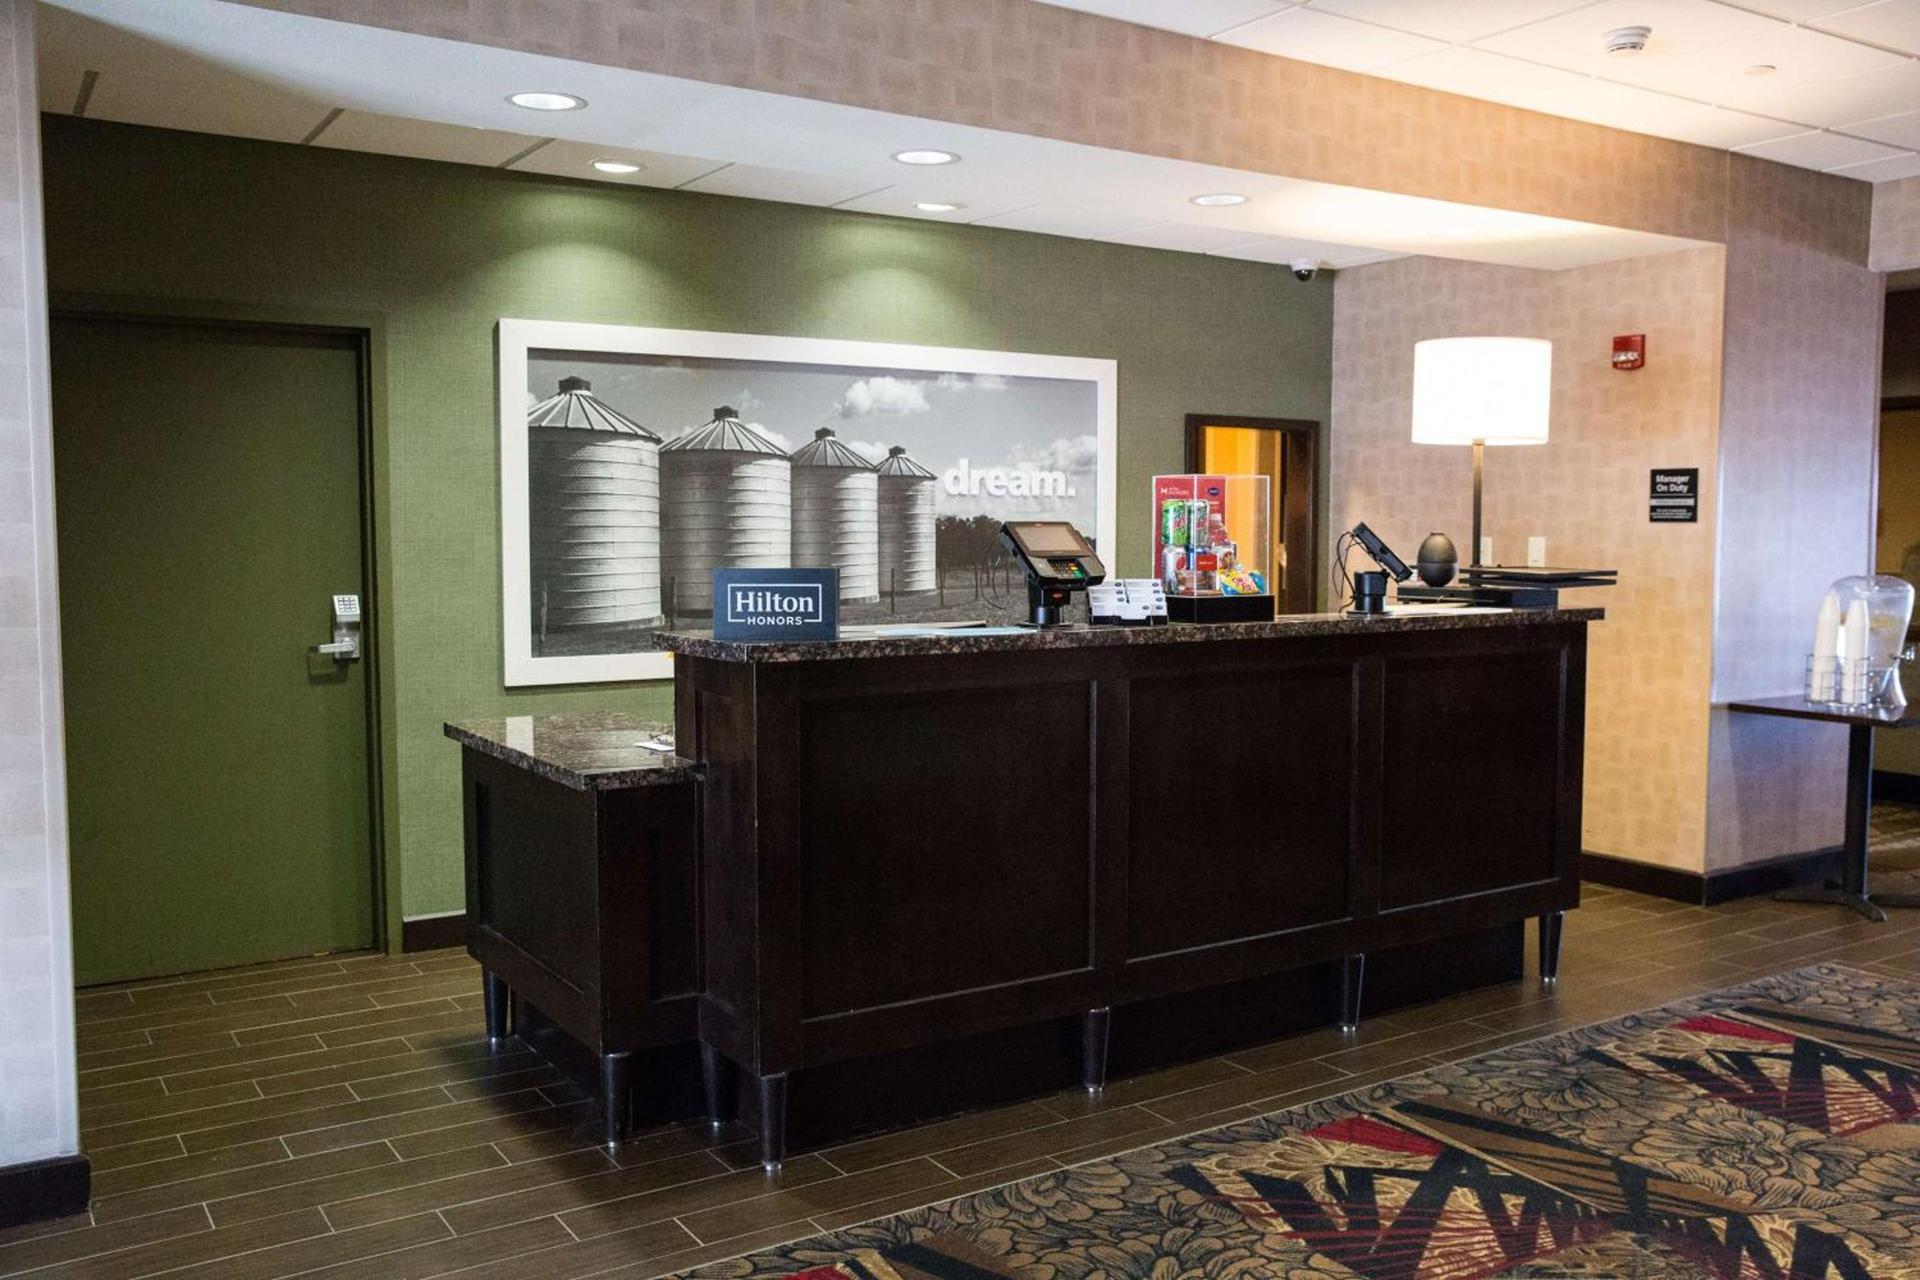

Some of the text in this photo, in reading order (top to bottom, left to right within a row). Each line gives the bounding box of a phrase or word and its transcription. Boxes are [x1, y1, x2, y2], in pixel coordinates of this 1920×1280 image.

[944, 458, 1076, 497] dream.
[735, 591, 814, 612] Hilton
[747, 616, 802, 625] HONORS
